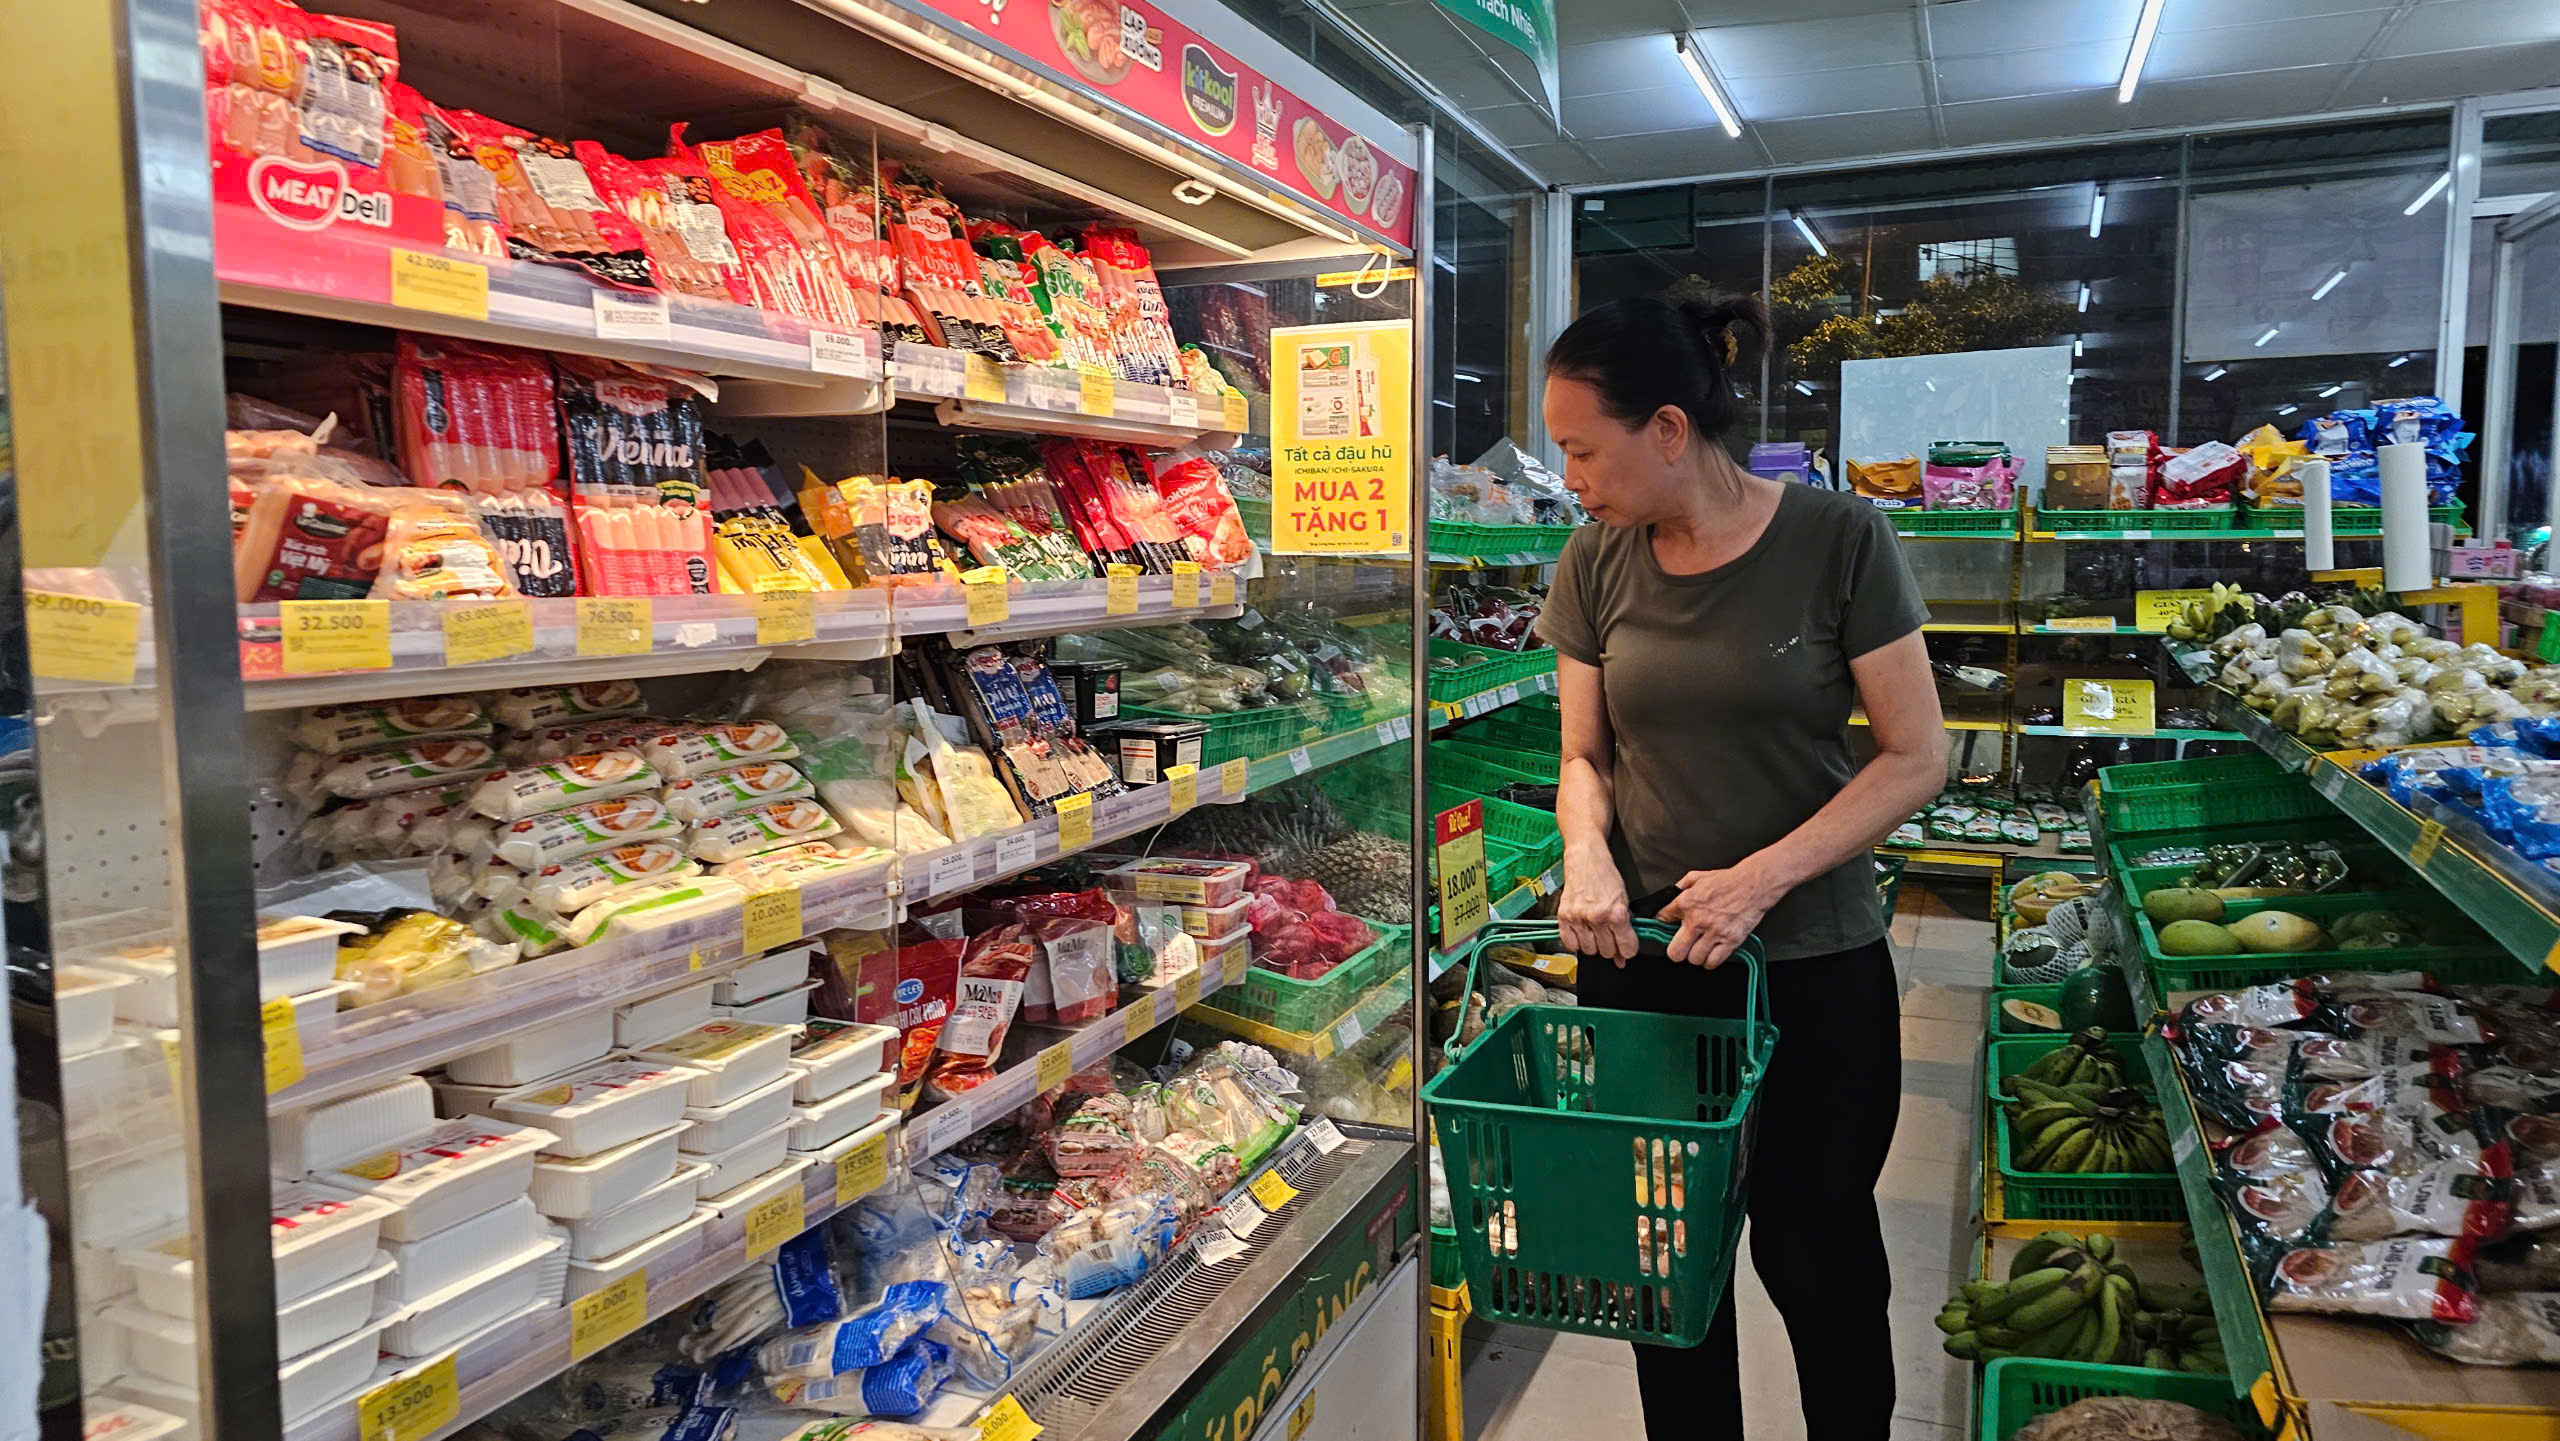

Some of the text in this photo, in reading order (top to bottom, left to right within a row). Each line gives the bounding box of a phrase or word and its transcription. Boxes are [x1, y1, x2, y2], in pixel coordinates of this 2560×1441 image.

[267, 175, 387, 222] MEAT Deli
[1284, 445, 1392, 463] Tất cả đậu hũ
[1295, 477, 1385, 502] MUA 2
[1290, 506, 1387, 538] TẶNG 1
[299, 615, 364, 632] 32.500
[1447, 864, 1477, 900] 18.000
[752, 903, 788, 922] 10.000
[1225, 1199, 1247, 1221] 17.000
[1196, 1231, 1227, 1247] 17.000
[376, 1384, 433, 1427] 13.900
